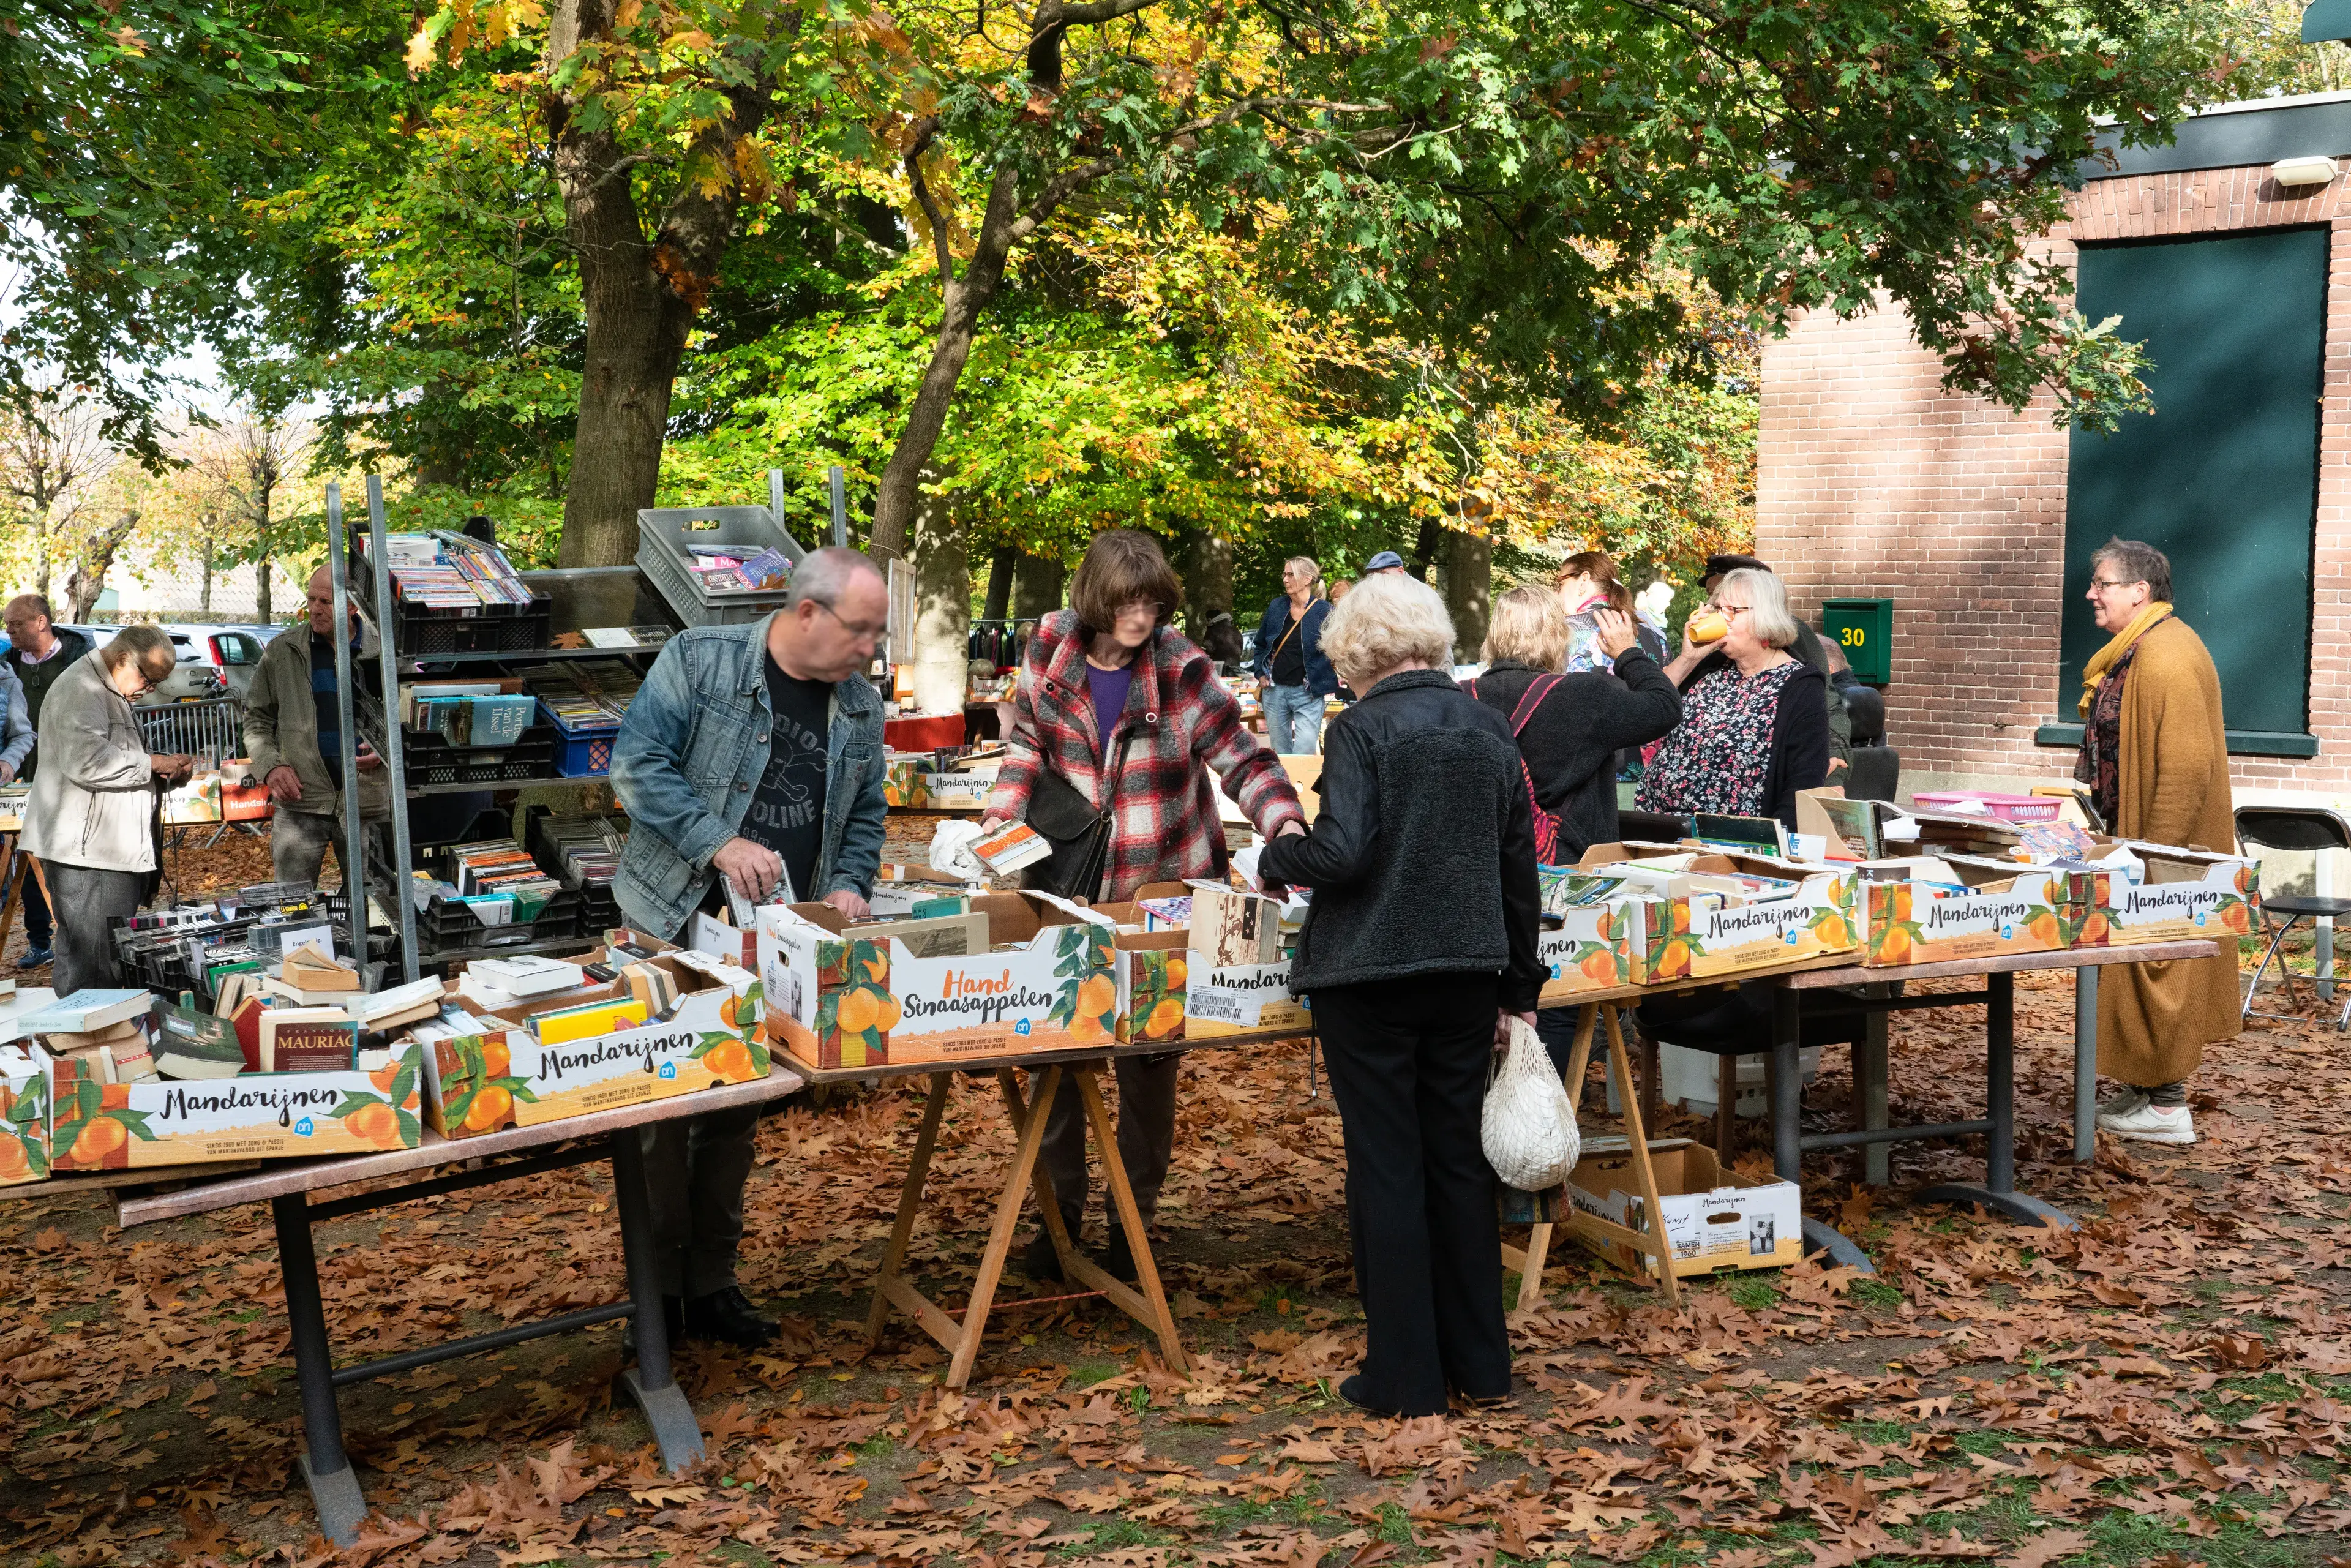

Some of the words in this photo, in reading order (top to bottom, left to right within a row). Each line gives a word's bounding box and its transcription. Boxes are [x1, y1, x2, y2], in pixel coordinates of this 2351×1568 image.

[1841, 628, 1864, 646] 30
[503, 708, 512, 724] van
[502, 726, 513, 738] de
[774, 713, 818, 751] DIO
[935, 777, 988, 795] Mandarijnen
[872, 891, 907, 903] Mandarijnen
[2124, 890, 2217, 919] Mandarijnen
[1707, 907, 1809, 939] Mandarijnen
[1928, 902, 2025, 932] Mandarijnen
[943, 969, 1015, 999] Hand
[1211, 970, 1292, 993] Mandari
[903, 986, 1052, 1024] Sinaasappelen
[277, 1034, 356, 1049] MAURIAC
[537, 1033, 694, 1081] Mandarijnen
[160, 1086, 337, 1127] Mandarijnen
[1702, 1197, 1745, 1209] Mandarijnen
